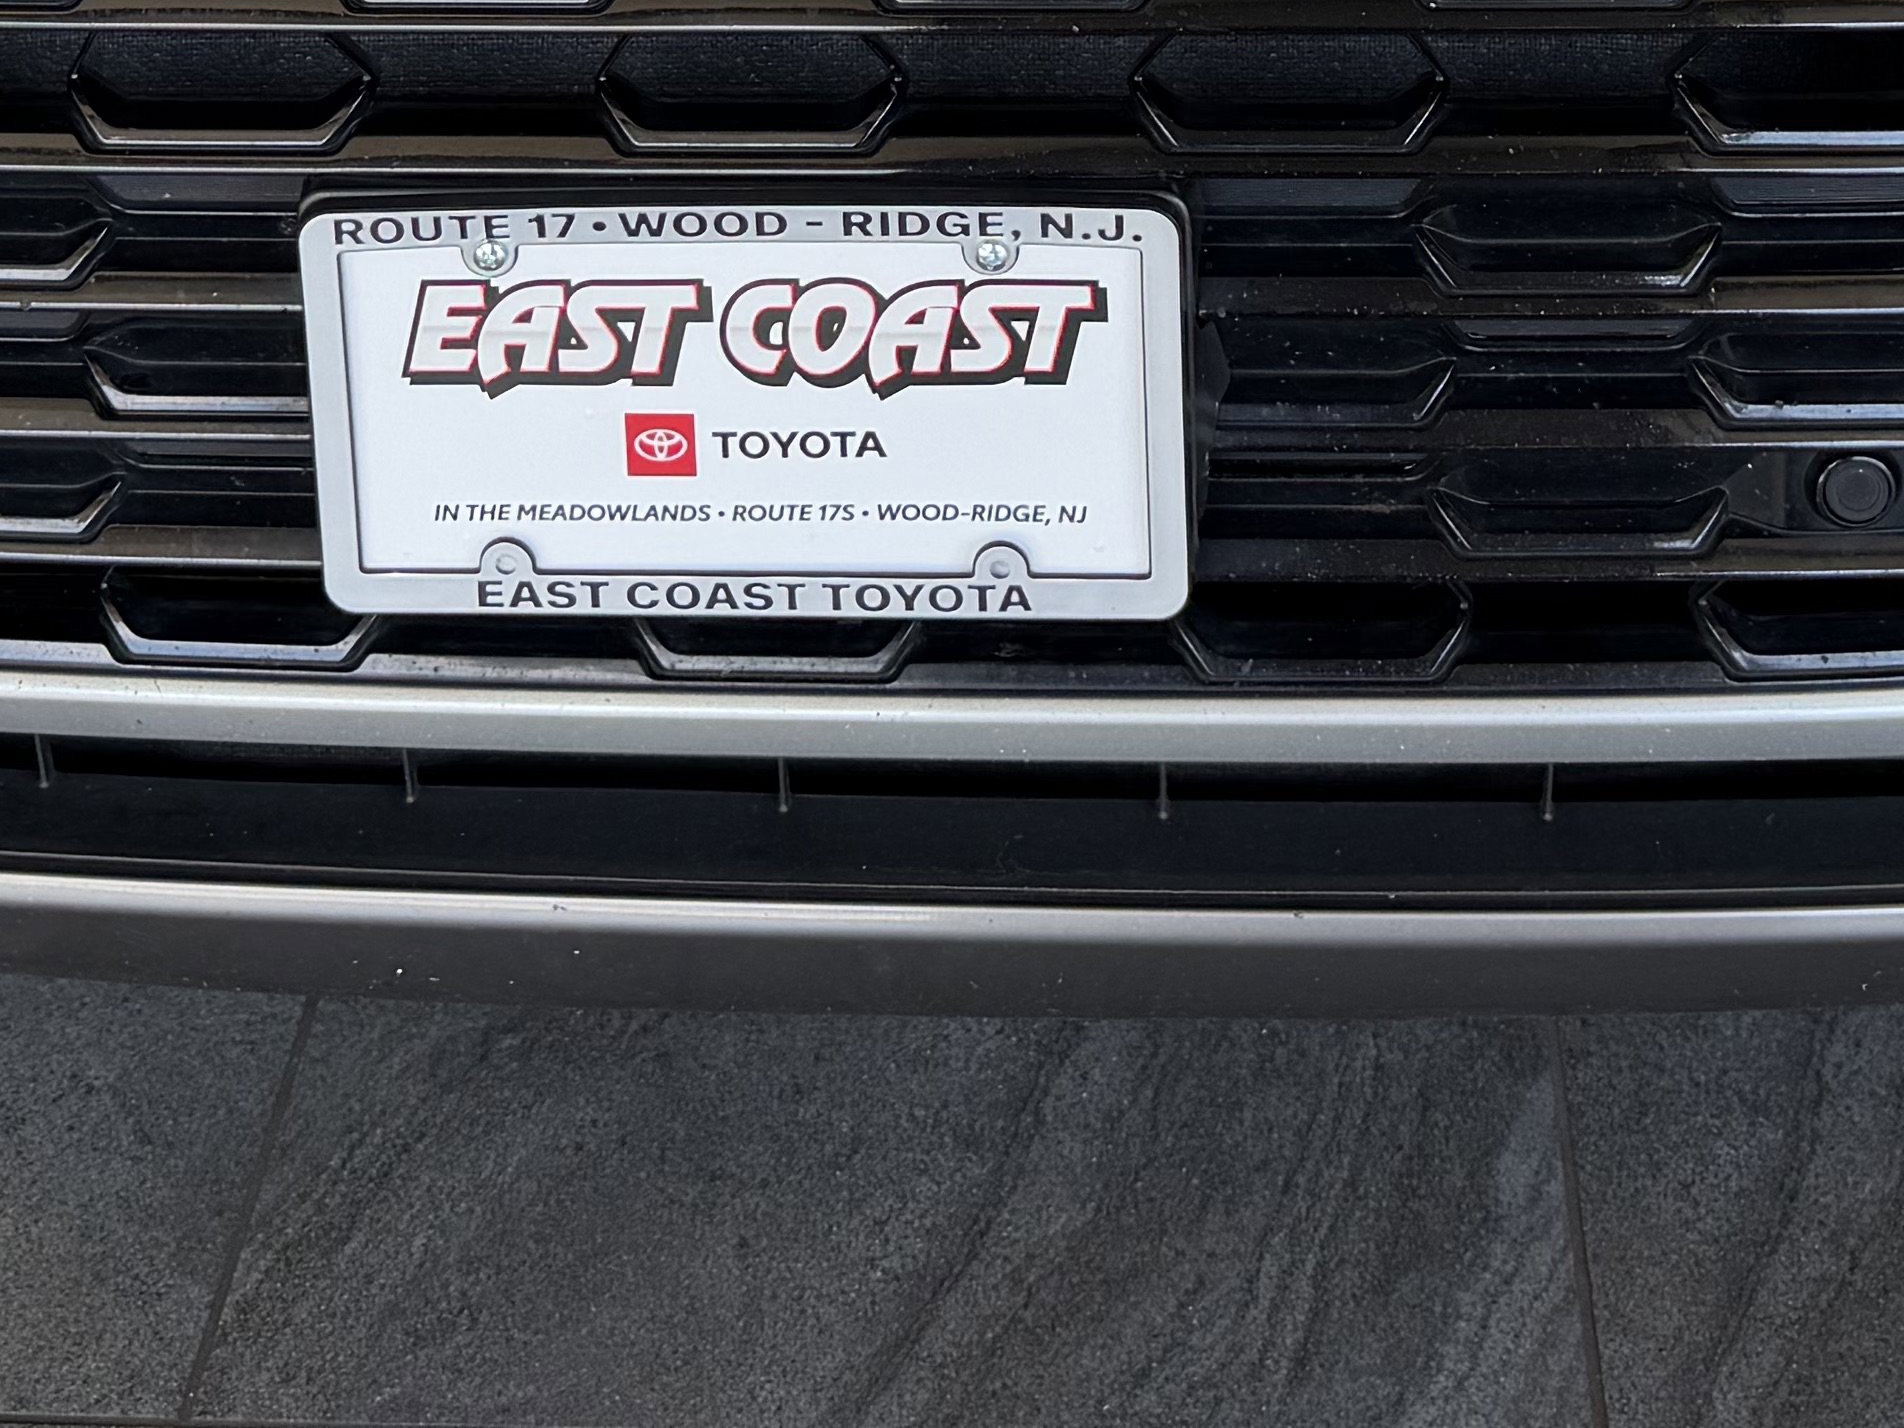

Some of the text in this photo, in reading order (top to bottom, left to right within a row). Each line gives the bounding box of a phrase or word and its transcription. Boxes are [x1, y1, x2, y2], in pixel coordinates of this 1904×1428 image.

[333, 214, 509, 245] ROUTE
[527, 212, 576, 239] 17
[618, 211, 788, 238] WOOD
[842, 211, 1021, 242] RIDGE,
[1040, 213, 1144, 241] N.J.
[401, 276, 1109, 401] EAST COAST
[711, 430, 887, 459] TOYOTA
[434, 504, 1088, 527] IN THE MEADOWLANDS ROUTE 17S WOOD-RIDGE, NJ
[477, 580, 1033, 613] EAST COAST TOYOTA
